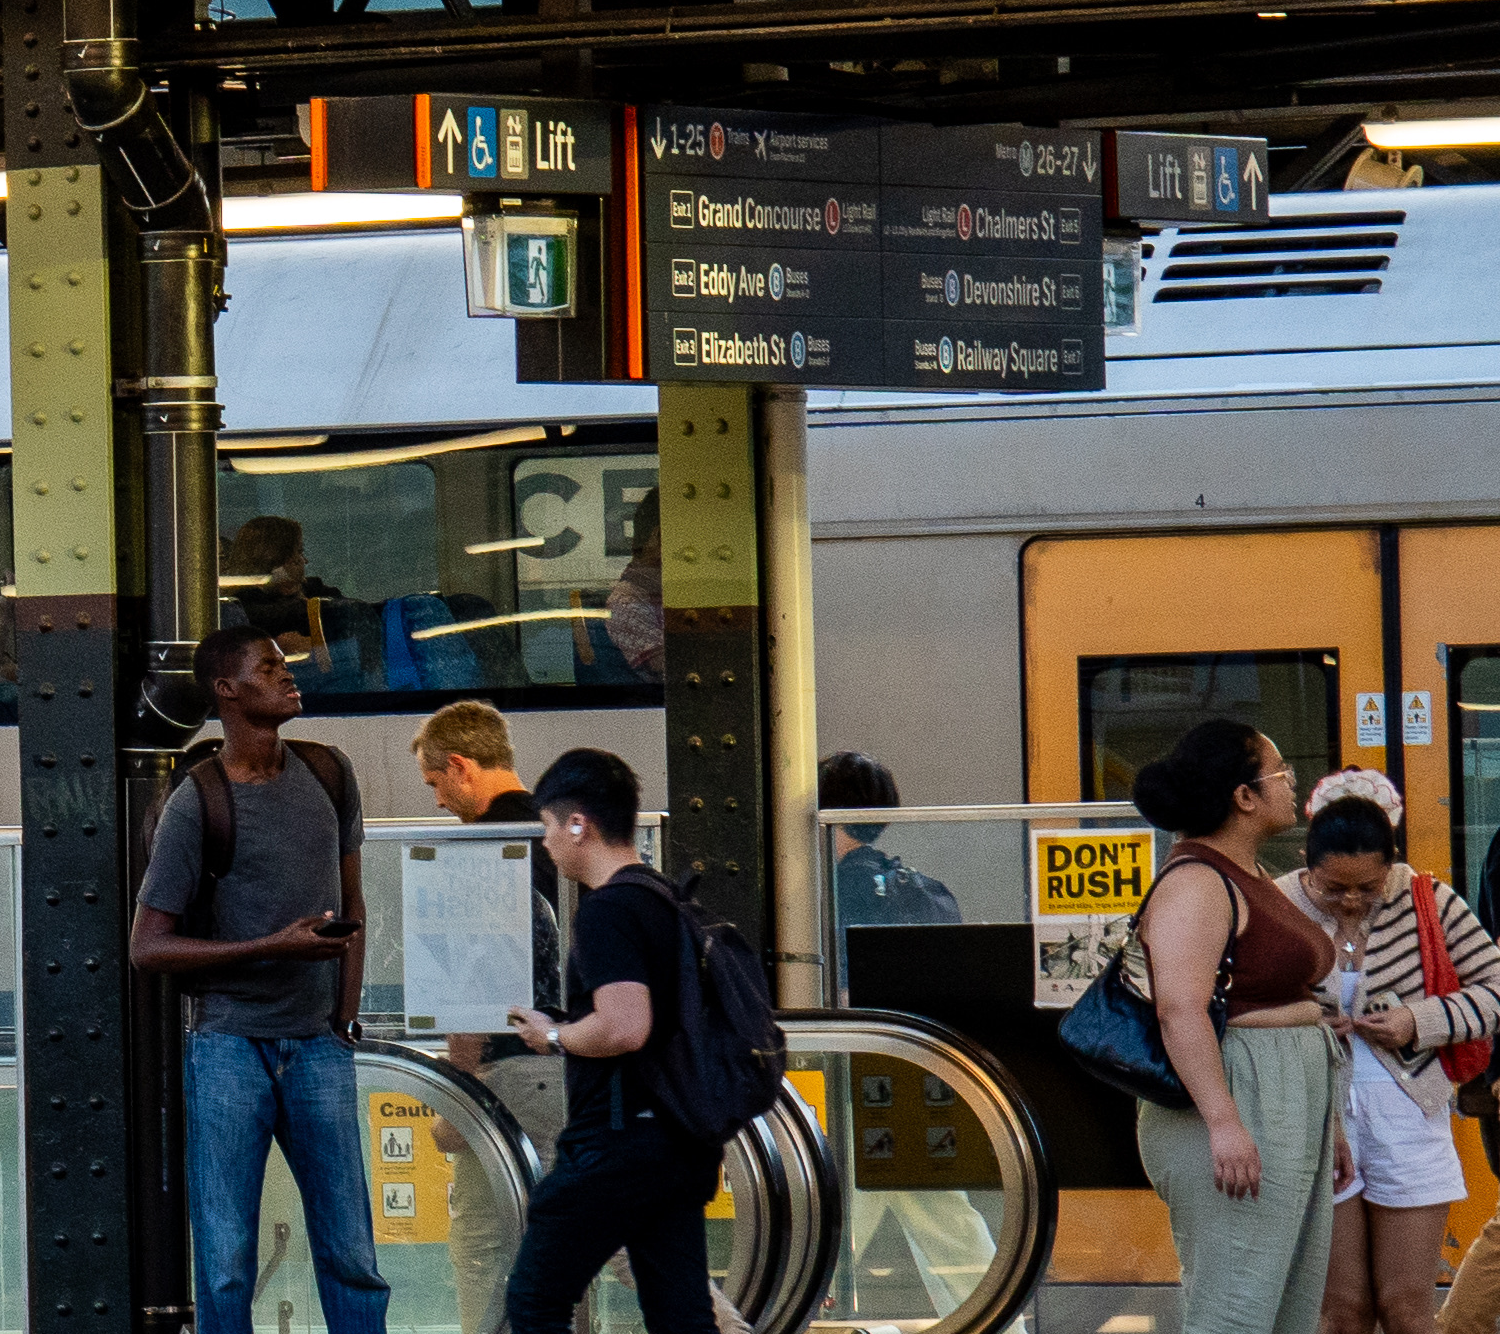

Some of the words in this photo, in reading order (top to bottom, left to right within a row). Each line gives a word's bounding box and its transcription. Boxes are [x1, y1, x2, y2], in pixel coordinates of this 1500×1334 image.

[535, 121, 576, 172] Lift
[670, 123, 705, 156] 1-25
[770, 131, 796, 150] Airport
[797, 135, 829, 151] services
[1036, 145, 1079, 176] 26-27
[1148, 154, 1182, 200] Lift
[672, 201, 686, 217] Exit
[698, 194, 742, 229] Grand
[745, 197, 821, 231] Concourse
[975, 208, 1039, 241] Chalmers
[1041, 210, 1055, 241] St
[674, 269, 687, 286] Exit
[688, 270, 694, 286] 2
[700, 263, 736, 303] Eddy
[738, 266, 765, 297] Ave
[785, 267, 809, 285] Buses
[921, 272, 943, 290] Buses
[964, 274, 1039, 306] Devonshire
[1042, 276, 1056, 307] St
[1062, 283, 1074, 299] Exit
[675, 338, 689, 355] Exit
[689, 339, 695, 356] 3
[701, 331, 769, 365] Elizabeth
[771, 334, 787, 366] St
[808, 335, 830, 353] Buses
[914, 339, 937, 356] Buses
[957, 340, 1008, 378] Railway
[1010, 341, 1057, 379] Square
[1195, 494, 1205, 508] 4
[1047, 842, 1141, 873] DON'T
[1047, 866, 1142, 899] RUSH
